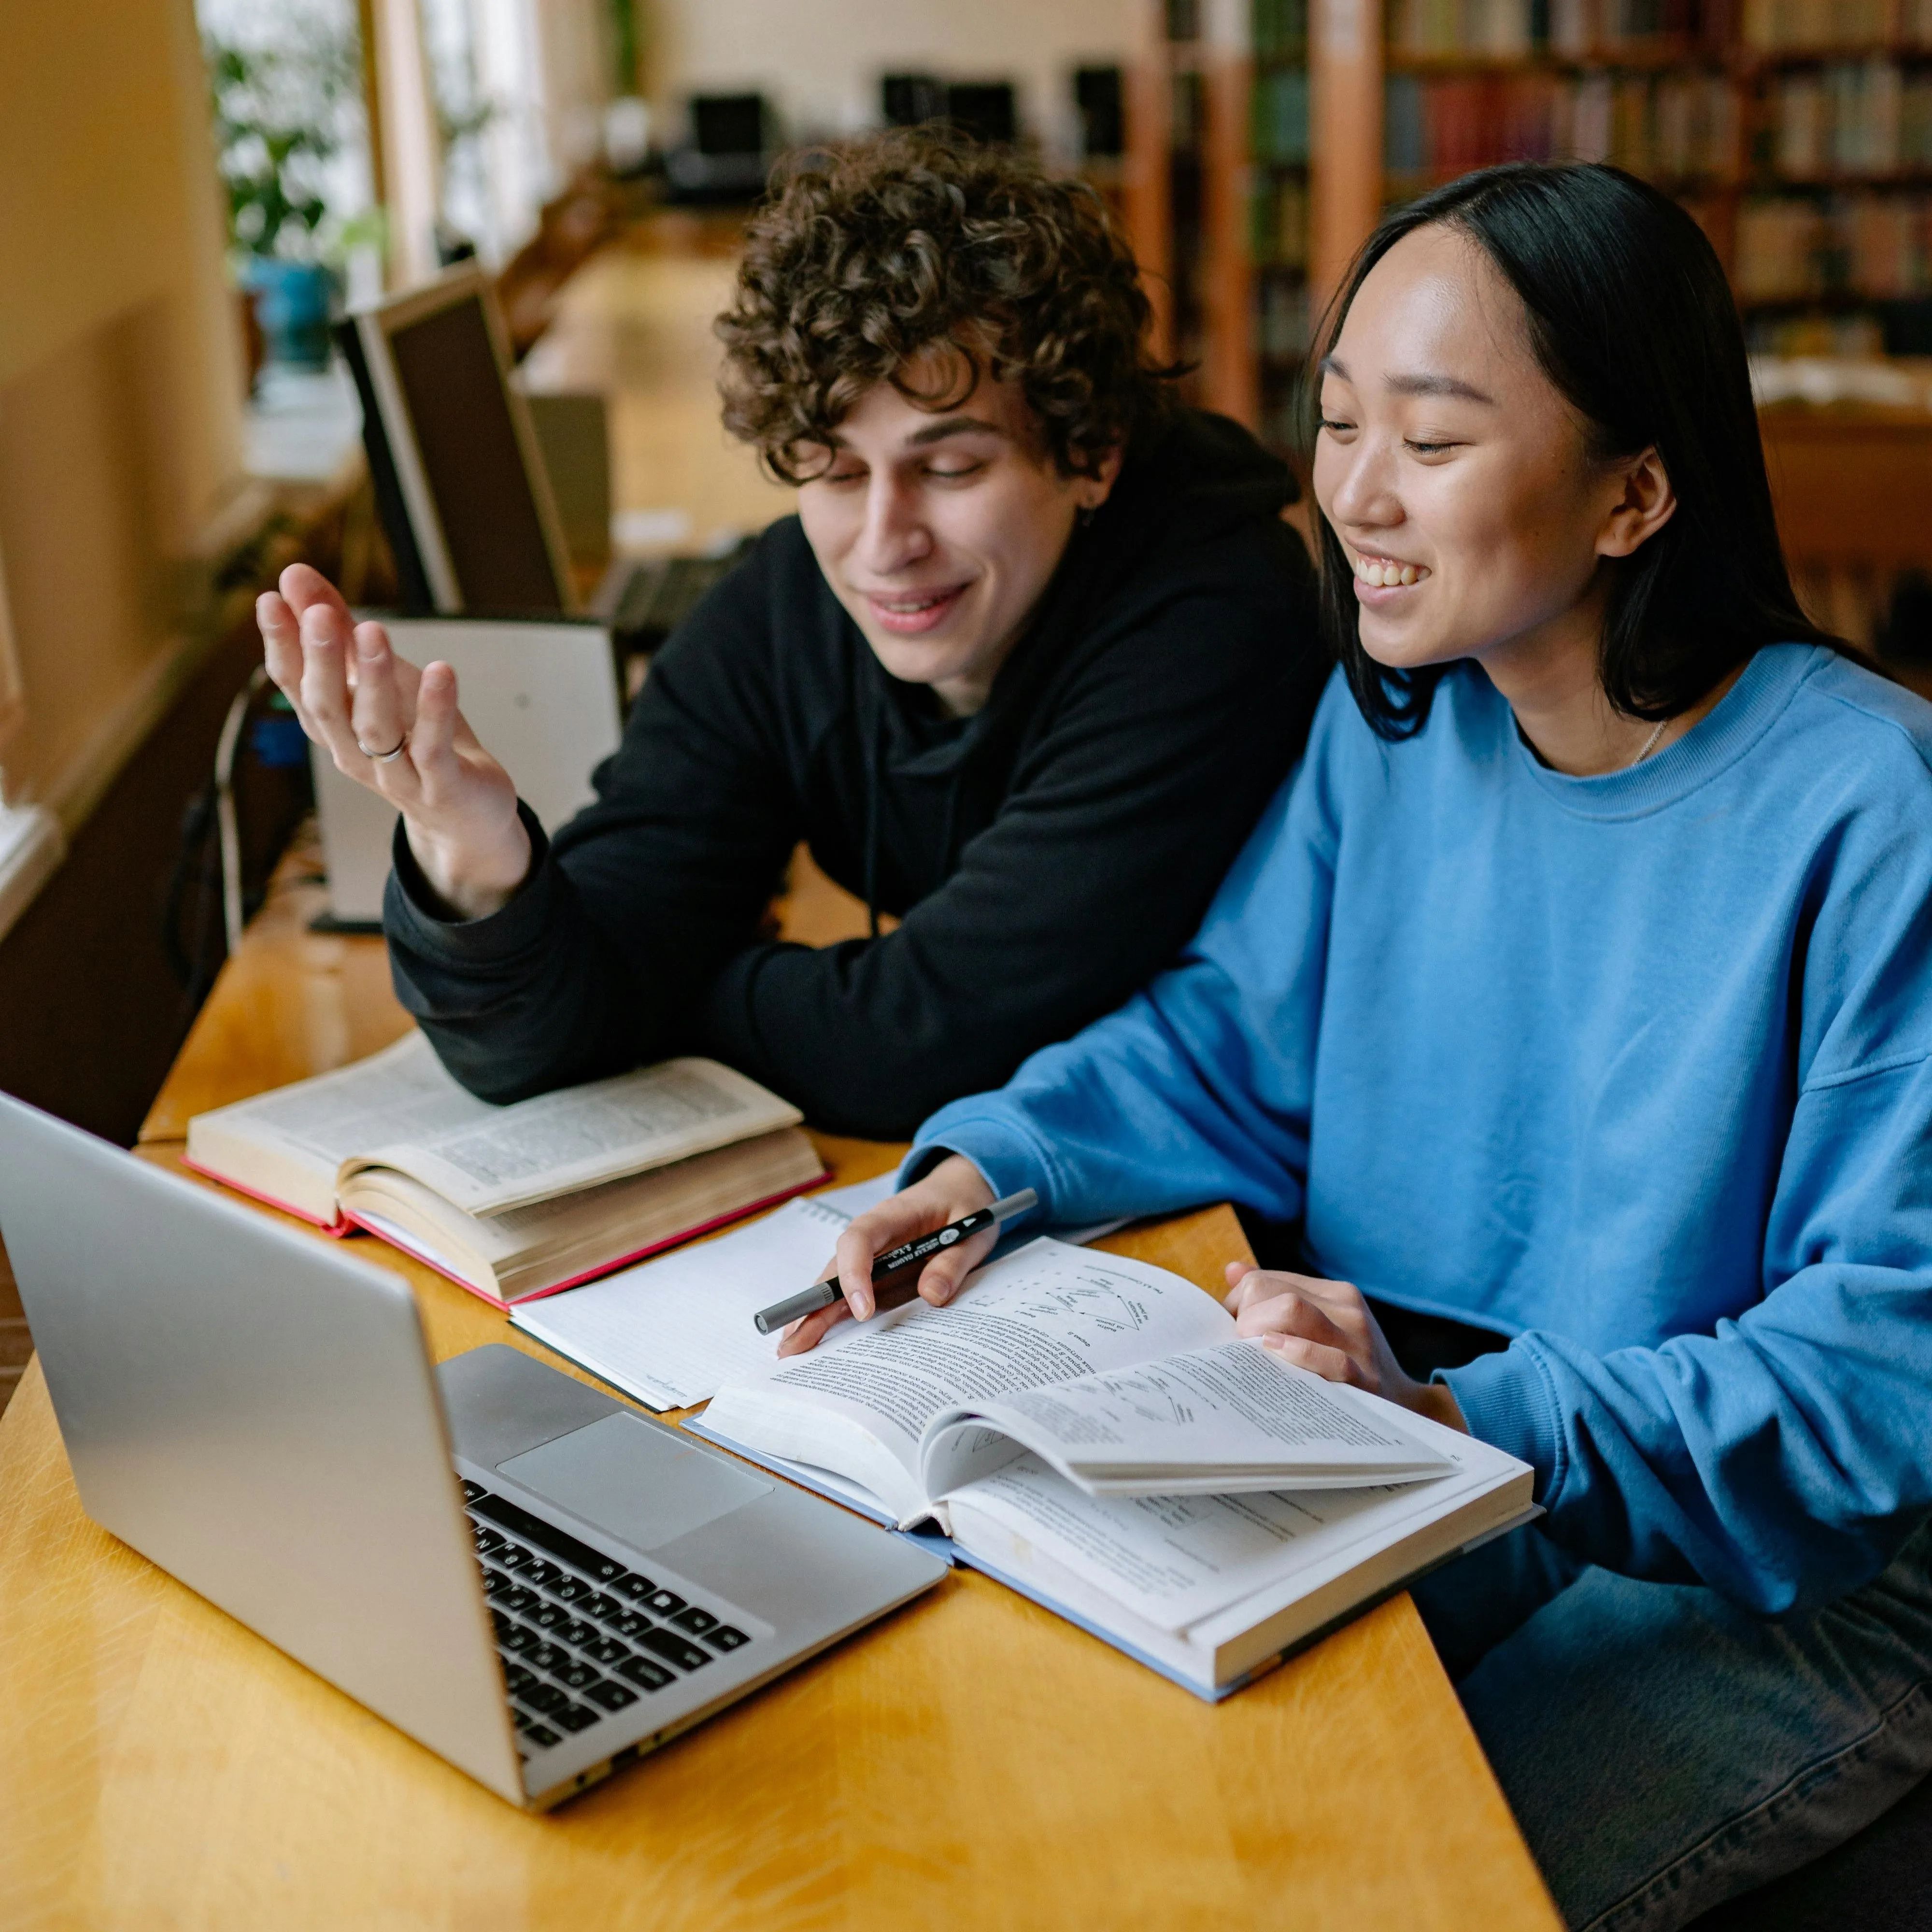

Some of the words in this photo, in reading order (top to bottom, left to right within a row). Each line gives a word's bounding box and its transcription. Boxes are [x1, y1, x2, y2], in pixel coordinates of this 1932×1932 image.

[1096, 1319, 1115, 1327] рынок
[1029, 1334, 1062, 1352] разумным
[1074, 1334, 1090, 1347] Фирма
[1011, 1351, 1027, 1360] вид,
[1019, 1349, 1042, 1363] фирме
[1028, 1347, 1051, 1361] любом
[1032, 1342, 1061, 1360] прежний
[1055, 1341, 1084, 1361] ситуация
[972, 1365, 987, 1374] чем
[978, 1355, 1016, 1377] (сохранение
[983, 1364, 1008, 1379] фирмы
[1010, 1358, 1034, 1373] другое
[1024, 1359, 1044, 1373] имеет
[1037, 1361, 1051, 1370] что
[1048, 1360, 1062, 1370] при
[1064, 1355, 1088, 1375] фирмы
[941, 1377, 969, 1394] конечно,
[965, 1369, 1003, 1394] уменьшение
[984, 1372, 1010, 1391] больше,
[1003, 1378, 1018, 1387] для
